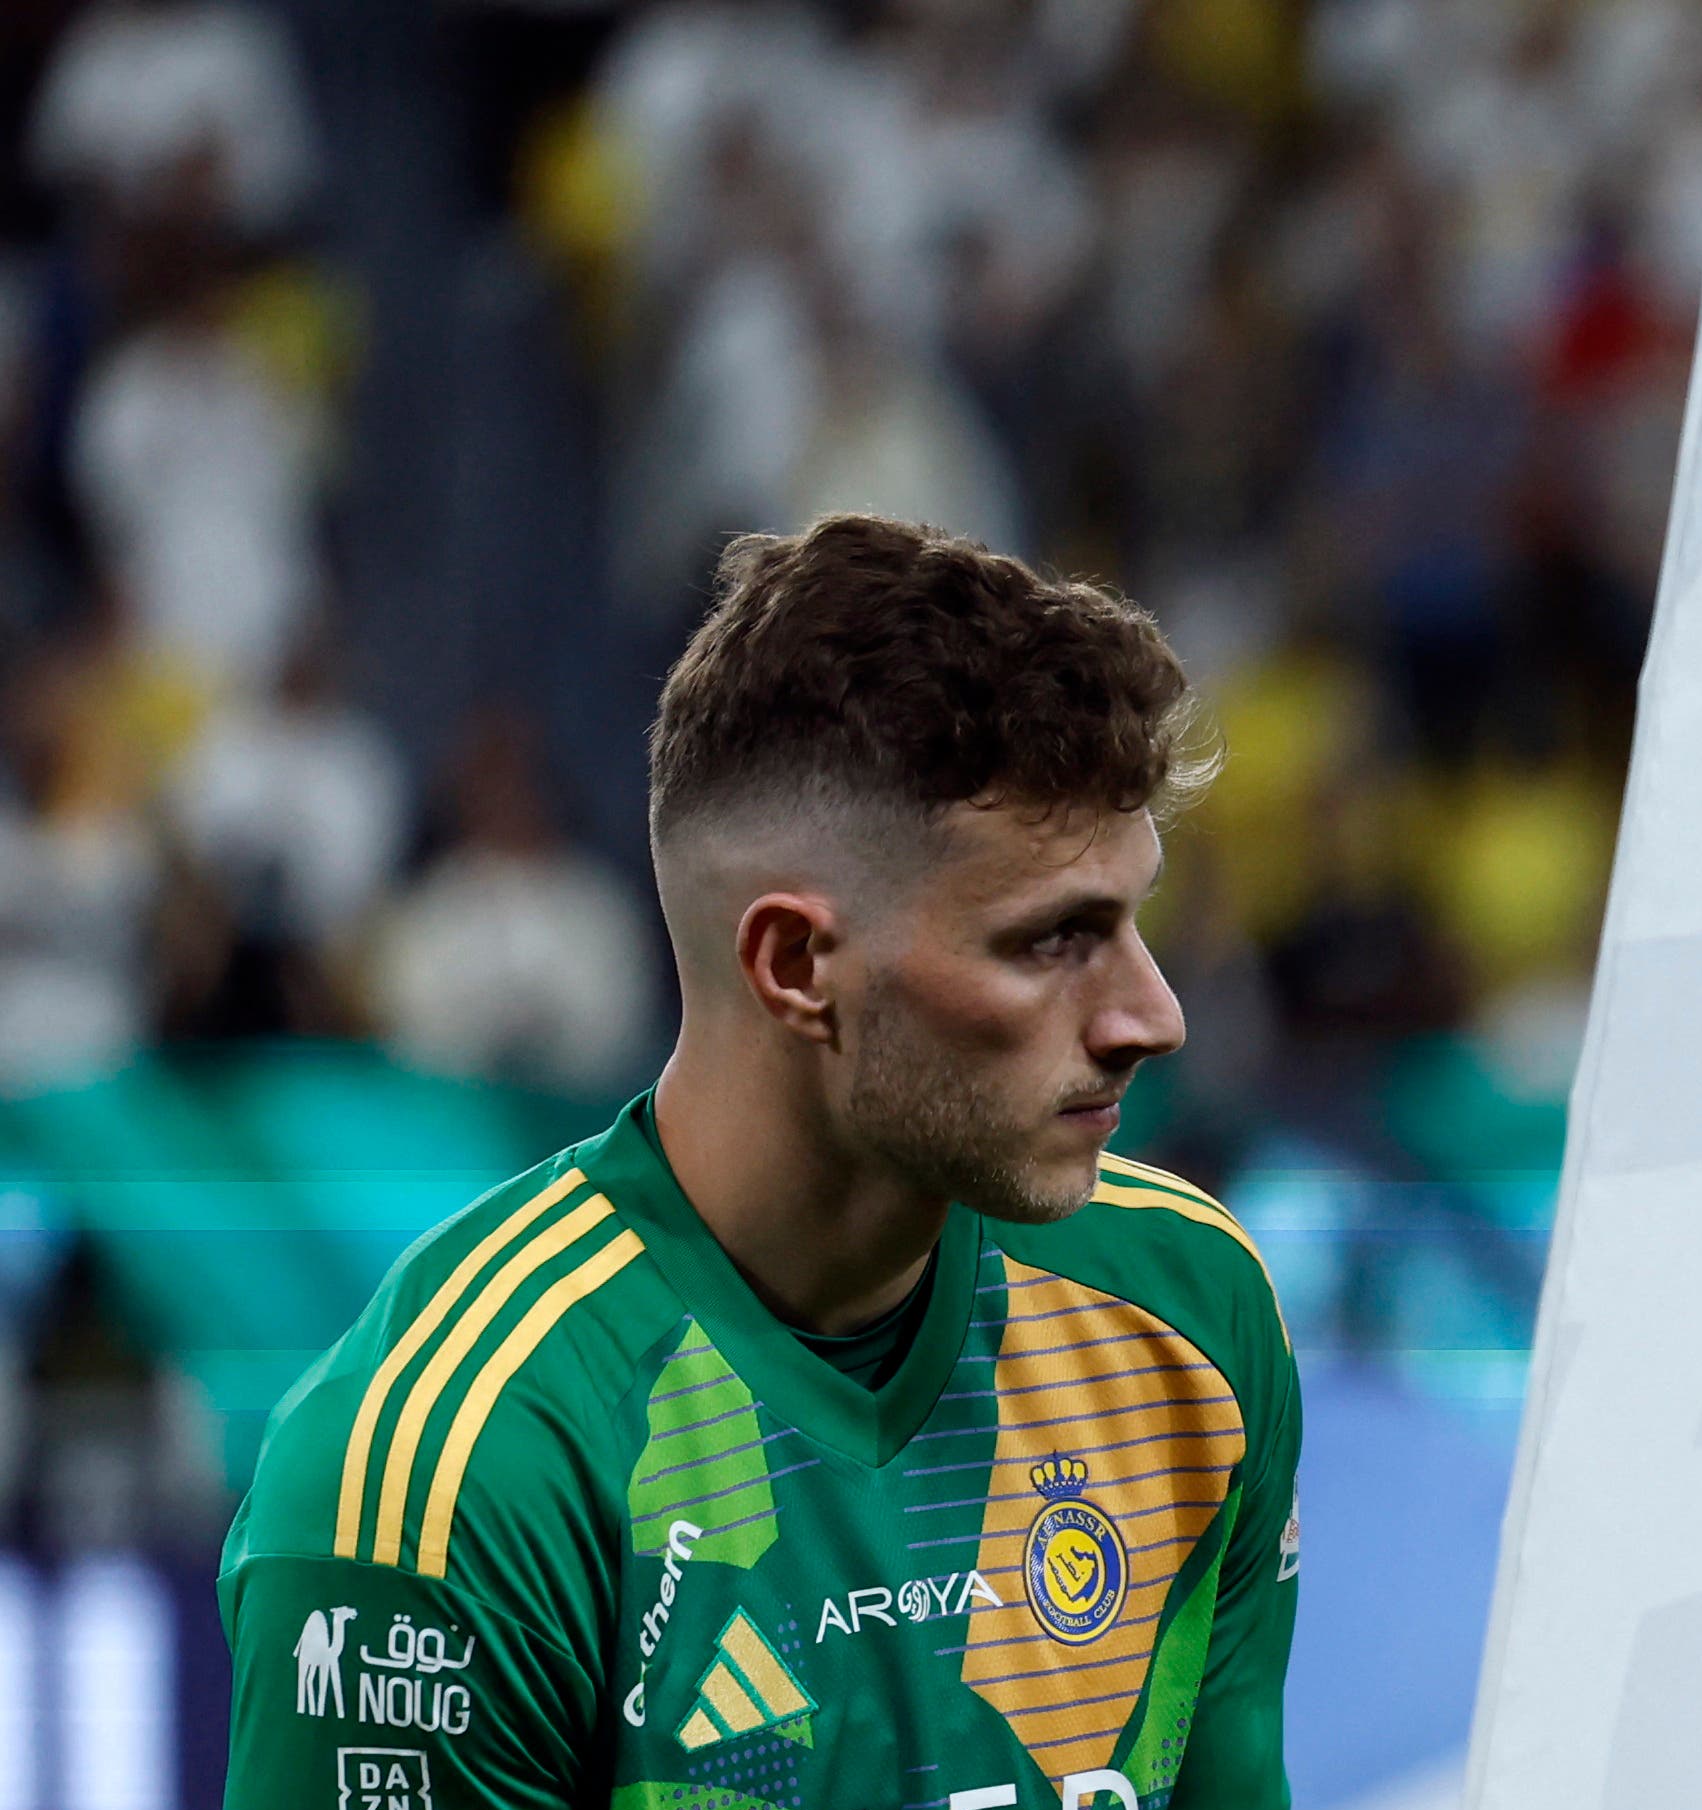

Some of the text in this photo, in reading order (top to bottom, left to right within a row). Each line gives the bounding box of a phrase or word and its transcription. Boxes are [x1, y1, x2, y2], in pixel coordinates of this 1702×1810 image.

[1052, 1510, 1108, 1543] NASSR
[815, 1569, 1004, 1644] AROYA
[1094, 1588, 1116, 1619] CLUB
[359, 1613, 476, 1674] نوق
[358, 1672, 472, 1735] NOUG
